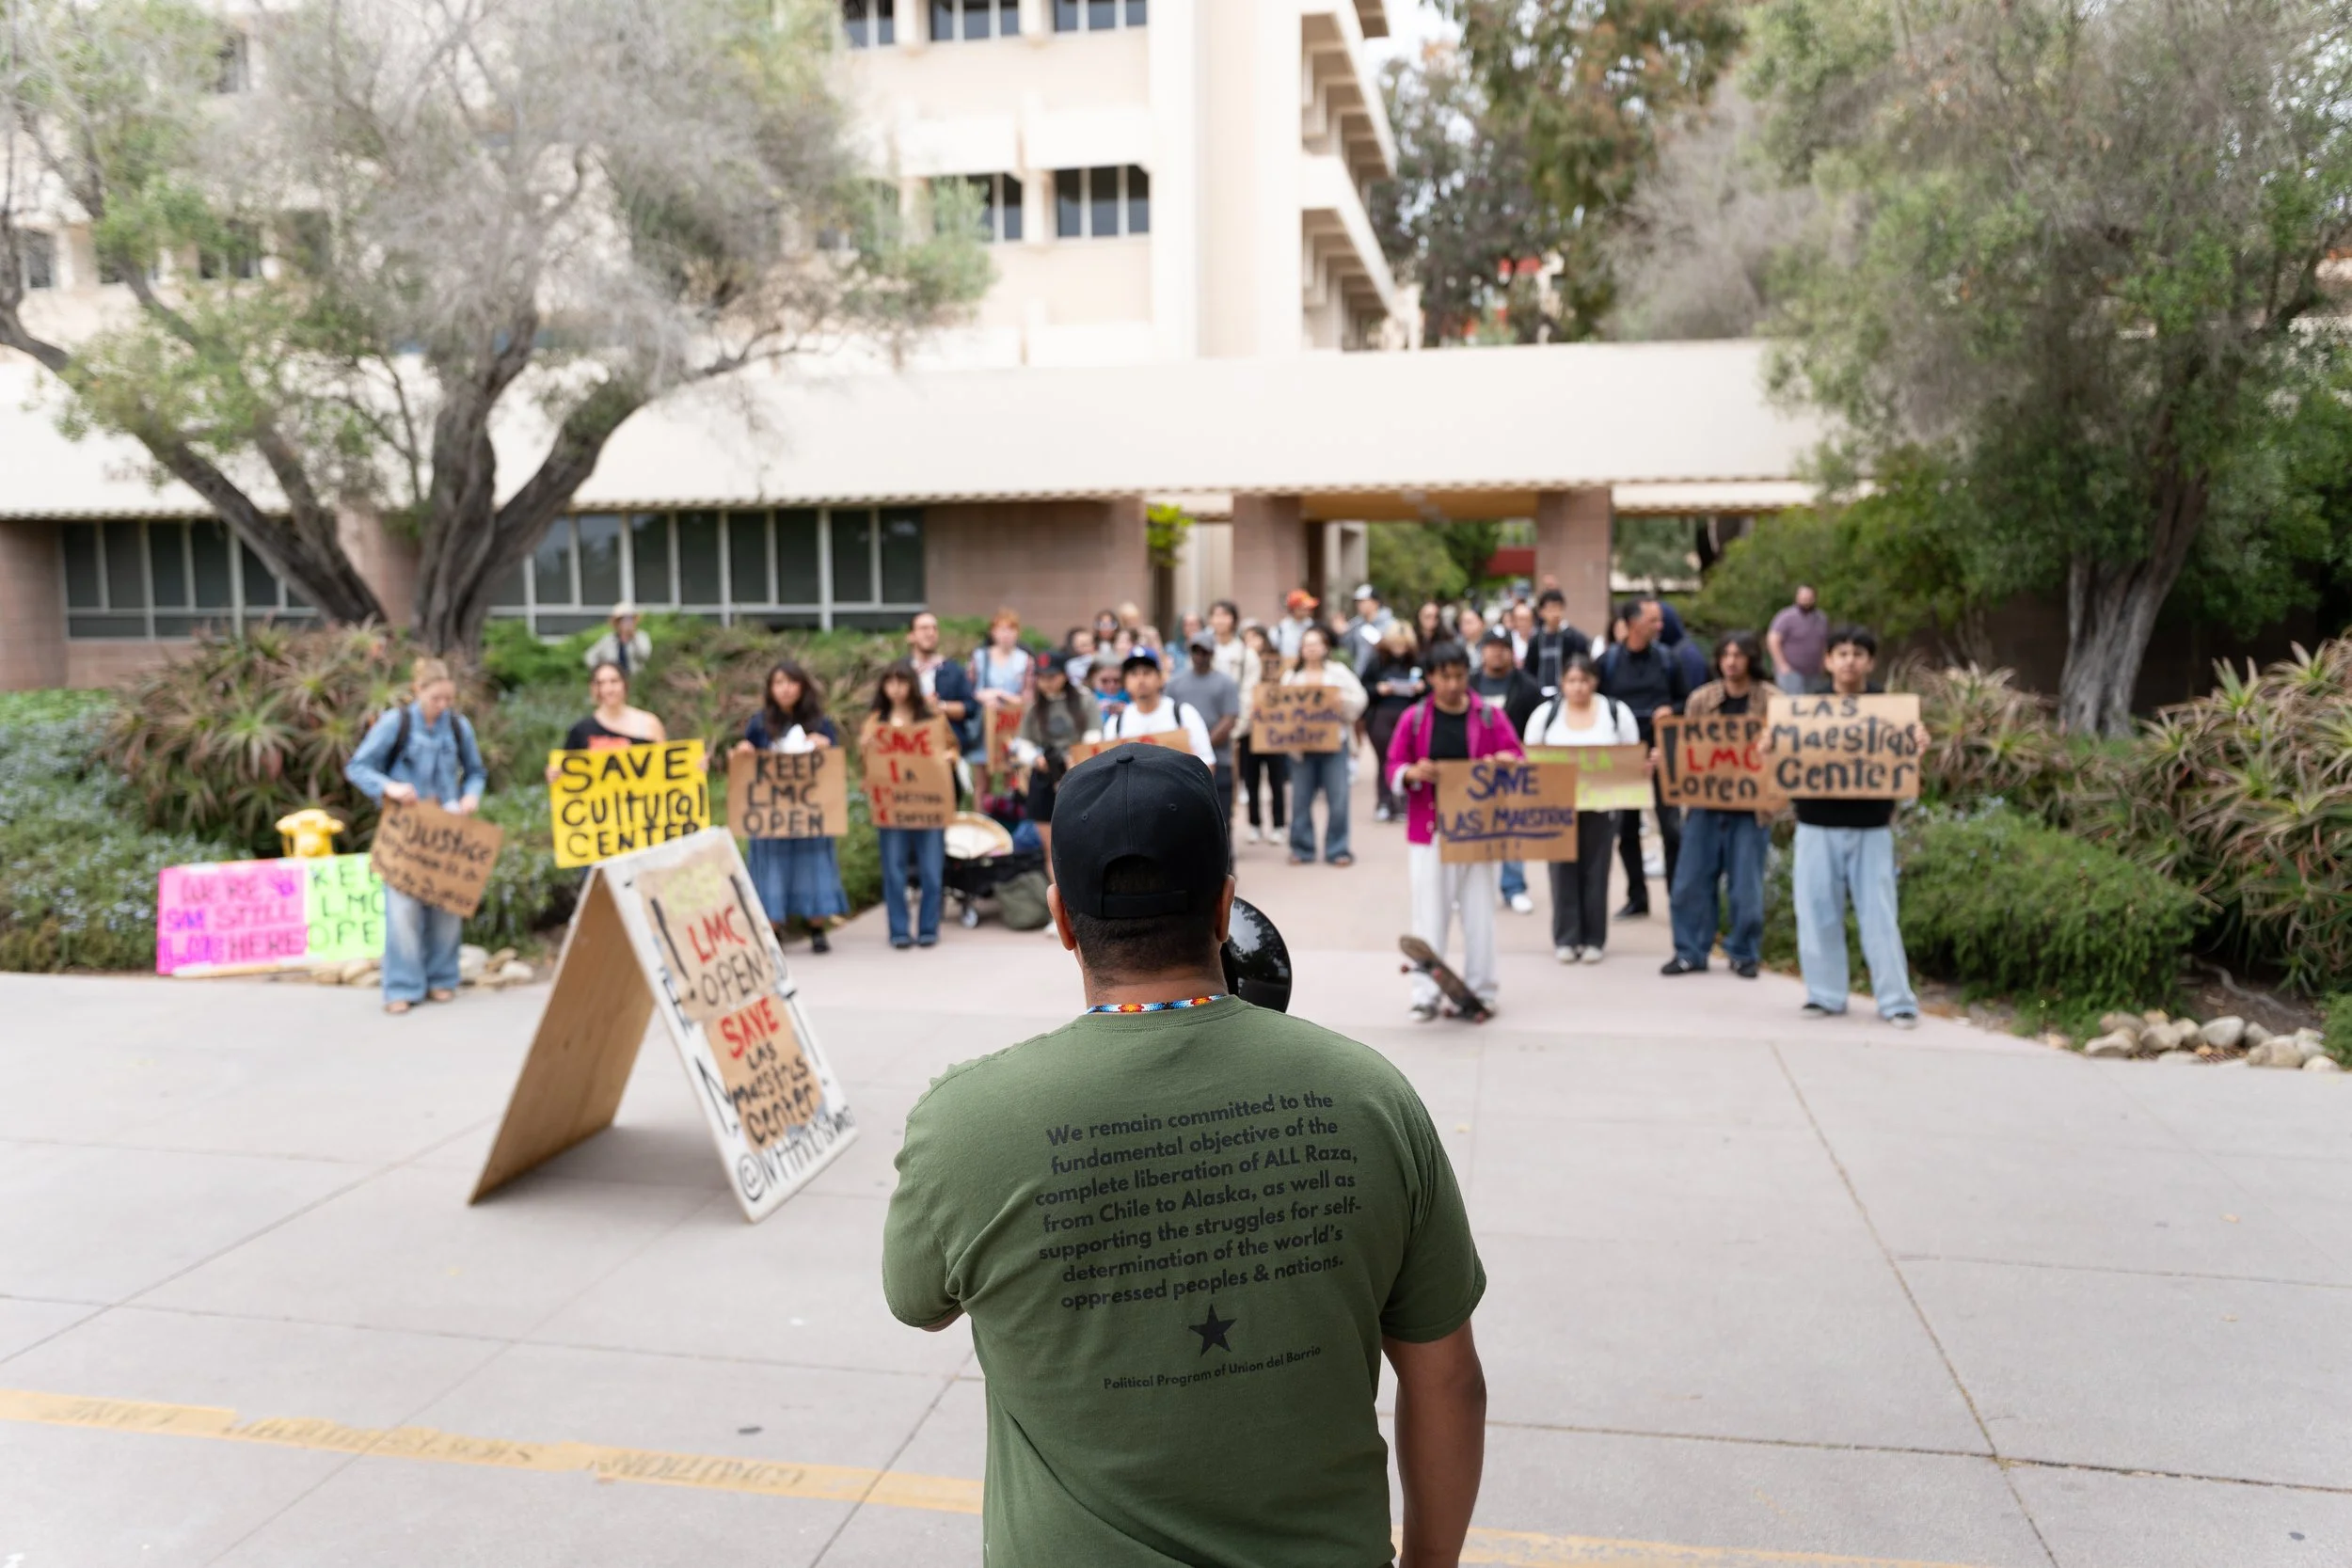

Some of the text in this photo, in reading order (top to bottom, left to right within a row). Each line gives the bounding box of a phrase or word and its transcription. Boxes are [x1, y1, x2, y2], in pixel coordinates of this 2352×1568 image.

[1790, 697, 1859, 717] LAS
[875, 726, 932, 757] SAVE
[1687, 744, 1762, 773] LMC
[561, 747, 690, 793] SAVE
[755, 753, 824, 784] KEEP
[1467, 764, 1539, 801] SAVE
[747, 783, 820, 808] LMC
[743, 812, 825, 834] OPEN
[311, 863, 383, 888] KEE
[308, 920, 376, 952] OPE
[687, 905, 746, 966] LMC
[701, 950, 765, 1006] OPEN
[720, 995, 780, 1059] SAVE
[1046, 1090, 1333, 1147] We remain committed to the
[1051, 1117, 1338, 1175] fundamental objective of the
[1035, 1144, 1358, 1207] complete liberation of ALL Raza,
[1042, 1170, 1356, 1232] from Chile to Alaska, as well as
[1039, 1196, 1361, 1261] supporting the struggles for self-
[1062, 1224, 1343, 1283] determination of the world's
[1060, 1255, 1343, 1311] oppressed peoples & nations.
[1104, 1346, 1321, 1389] Political Program of Union del Barrio
